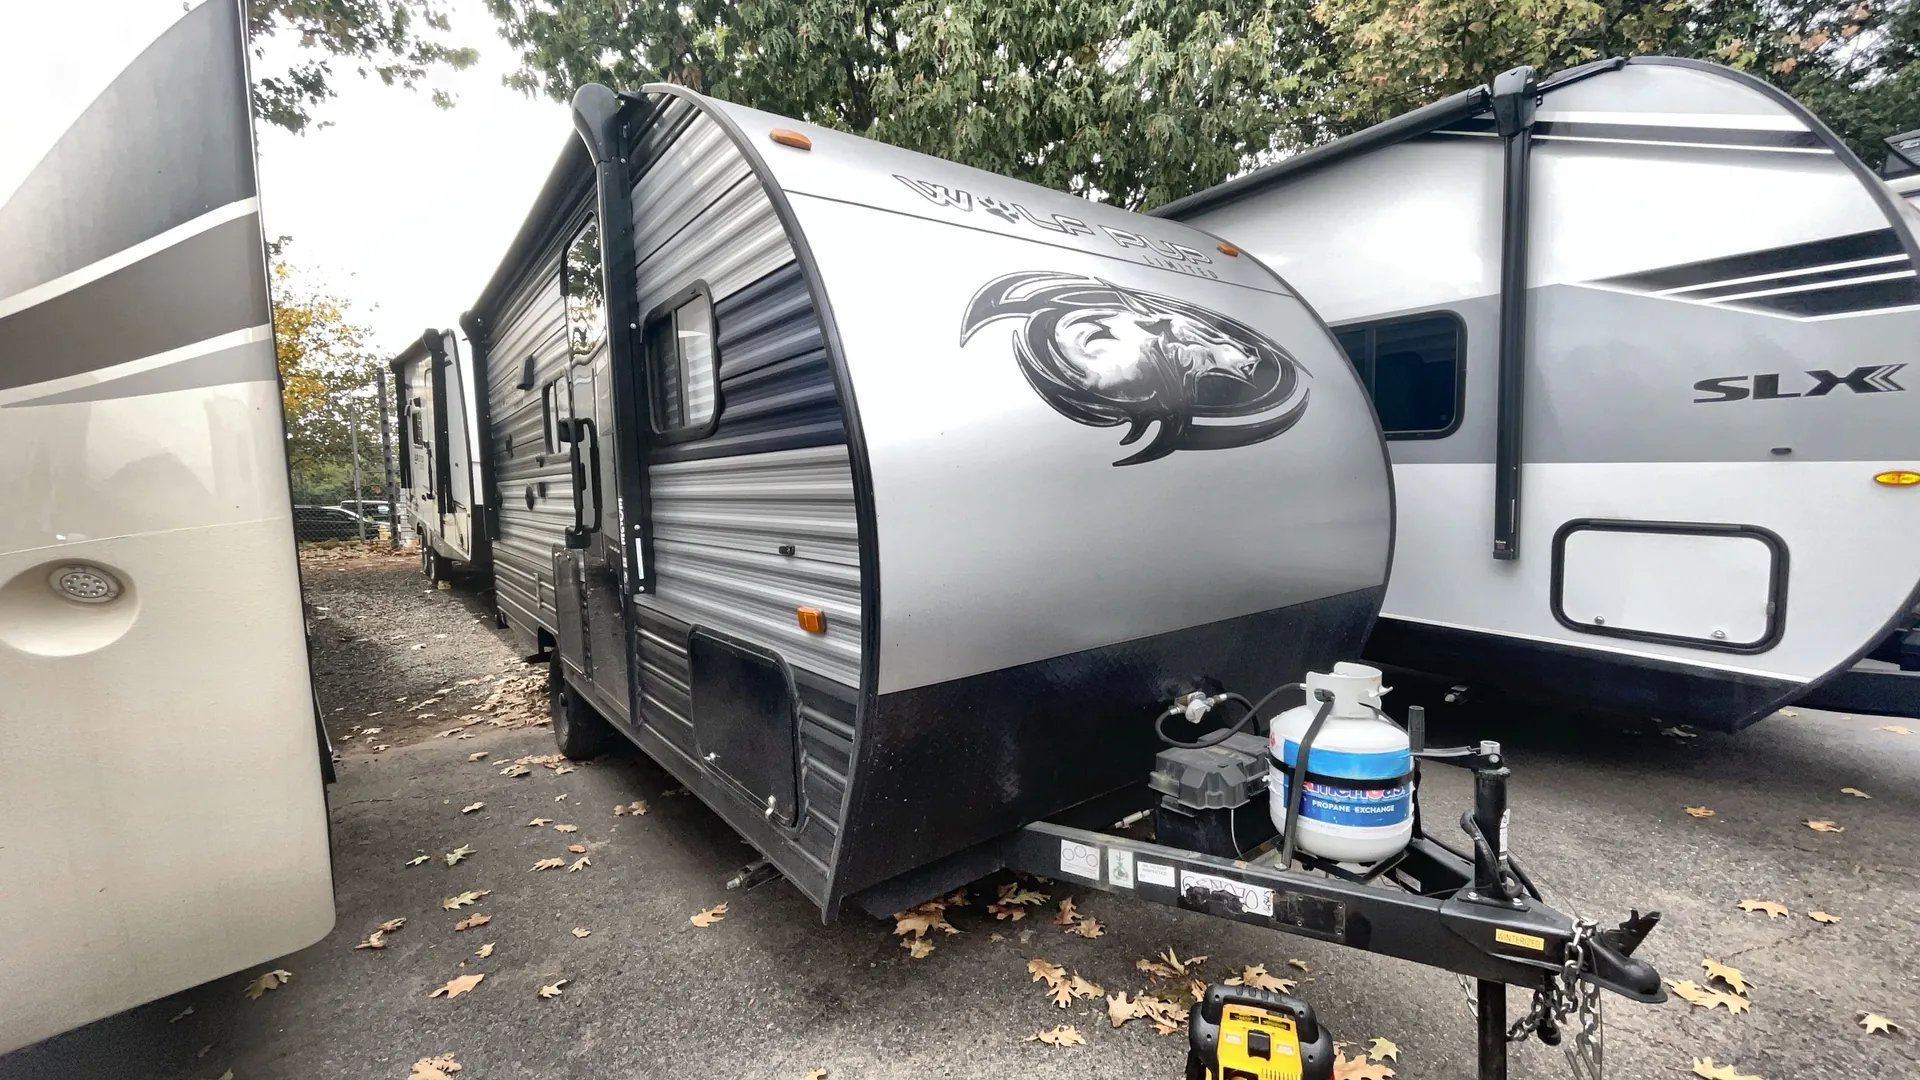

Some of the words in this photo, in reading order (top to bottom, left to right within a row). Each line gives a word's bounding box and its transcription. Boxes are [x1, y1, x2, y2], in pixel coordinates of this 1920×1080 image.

[1098, 224, 1213, 264] PUP
[1143, 255, 1218, 279] LIMITED
[1694, 363, 1908, 403] SLX
[1312, 799, 1350, 813] PROPANE
[1354, 804, 1395, 814] EXCHANGE
[1497, 930, 1541, 948] WINTERIZED
